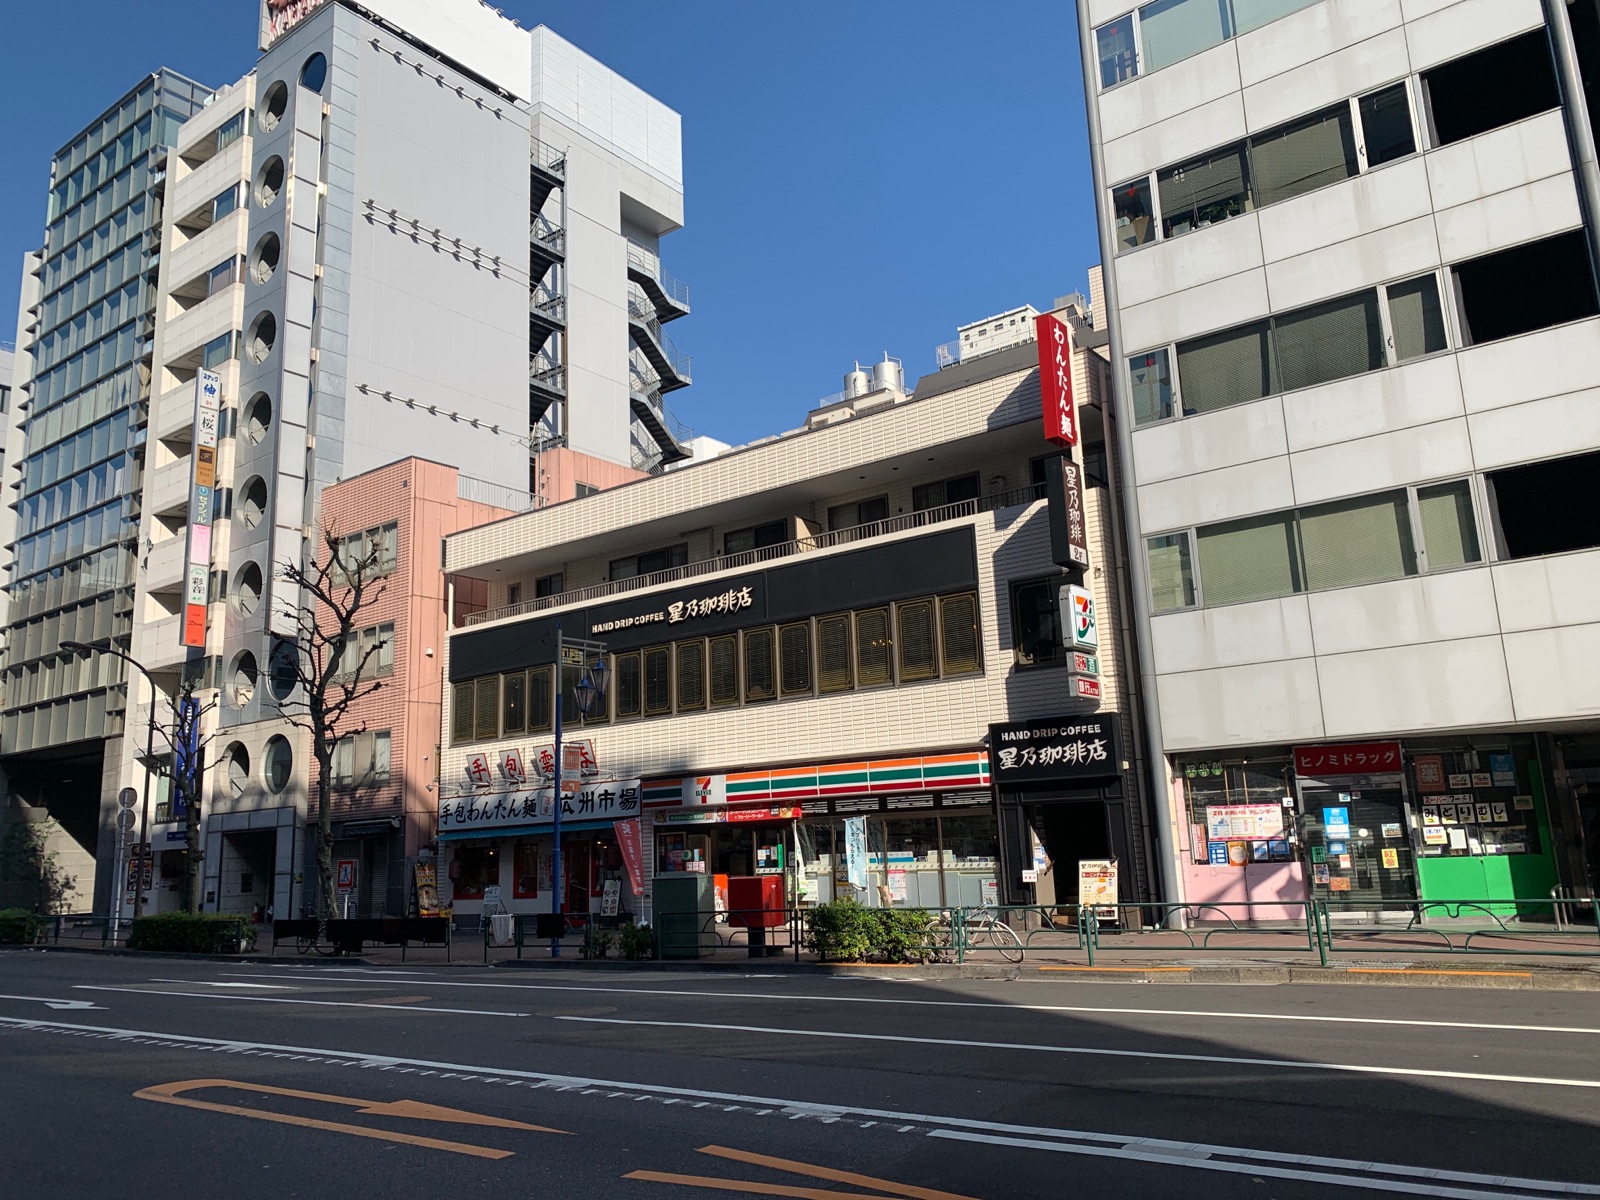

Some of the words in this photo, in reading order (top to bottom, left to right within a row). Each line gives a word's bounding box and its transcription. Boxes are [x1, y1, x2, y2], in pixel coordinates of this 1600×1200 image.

[1053, 323, 1074, 439] わんたん麺
[202, 417, 214, 431] 桜
[1064, 466, 1082, 543] 星乃珈琲
[1074, 547, 1083, 562] 2F
[667, 586, 754, 624] 星乃珈琲店
[592, 621, 614, 634] HAND
[614, 617, 634, 630] DRIP
[634, 611, 665, 625] COFFEE
[1001, 730, 1031, 741] HAND
[1032, 727, 1058, 739] DRIP
[1060, 724, 1101, 736] COFFEE
[997, 738, 1108, 770] 星乃珈琲店
[1301, 750, 1395, 768] ヒノミドラッグ
[440, 797, 537, 826] 手包わんたん麺
[560, 787, 638, 815] 広州市場
